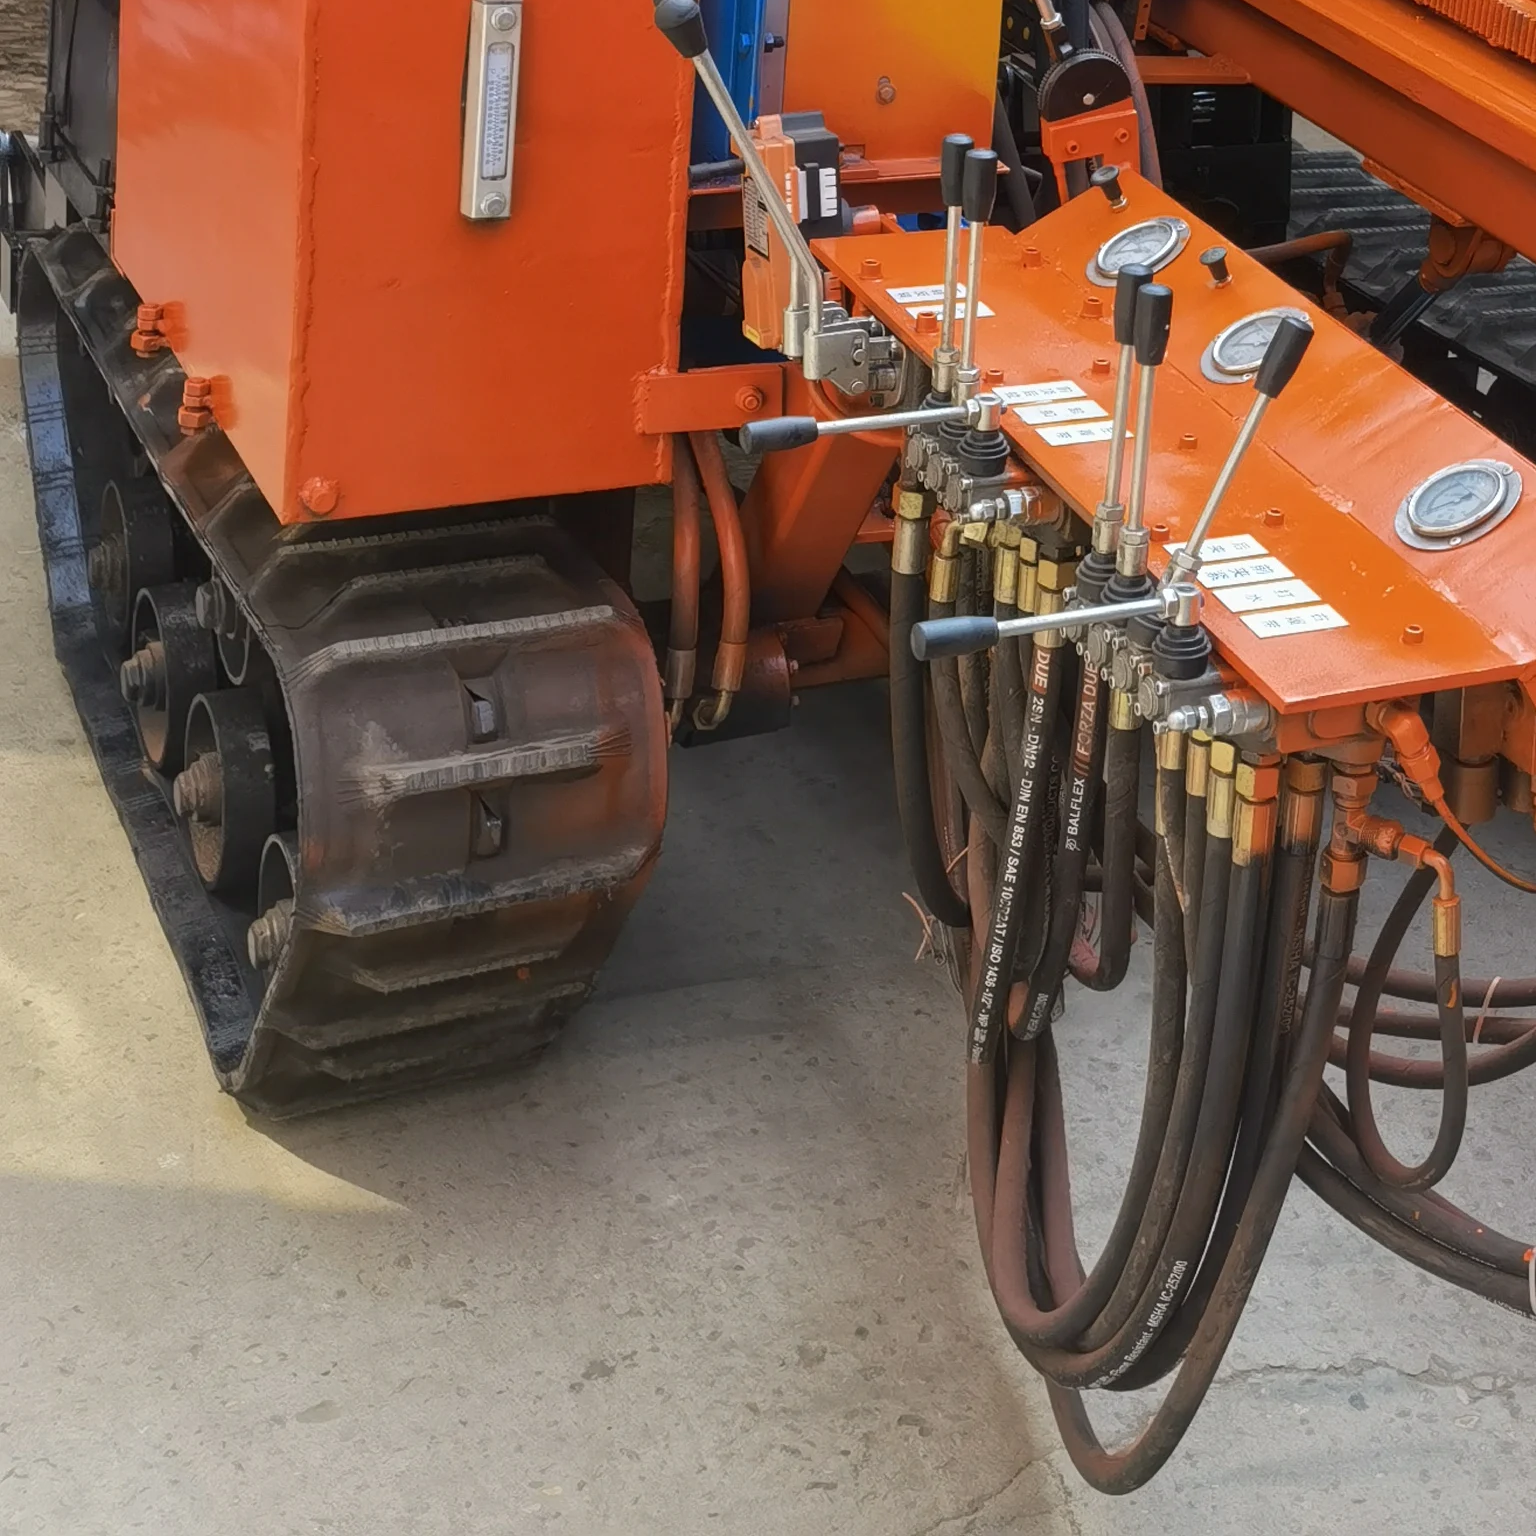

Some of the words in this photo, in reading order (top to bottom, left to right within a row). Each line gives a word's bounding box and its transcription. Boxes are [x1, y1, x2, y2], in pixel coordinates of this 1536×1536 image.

[1034, 649, 1050, 689] DUE
[1030, 696, 1044, 724] 2SN
[1023, 733, 1040, 769] DN12
[1067, 777, 1086, 835] BALFLEX
[1078, 702, 1095, 757] FORZA
[1019, 778, 1033, 803] DIN
[1015, 804, 1029, 824] EN
[1011, 824, 1025, 848] 853
[1004, 856, 1019, 884] SAE
[989, 944, 1003, 964] ISO
[1123, 1331, 1153, 1363] Resistant
[1146, 1302, 1169, 1328] MSHA
[1159, 1260, 1188, 1304] IC-252/00
